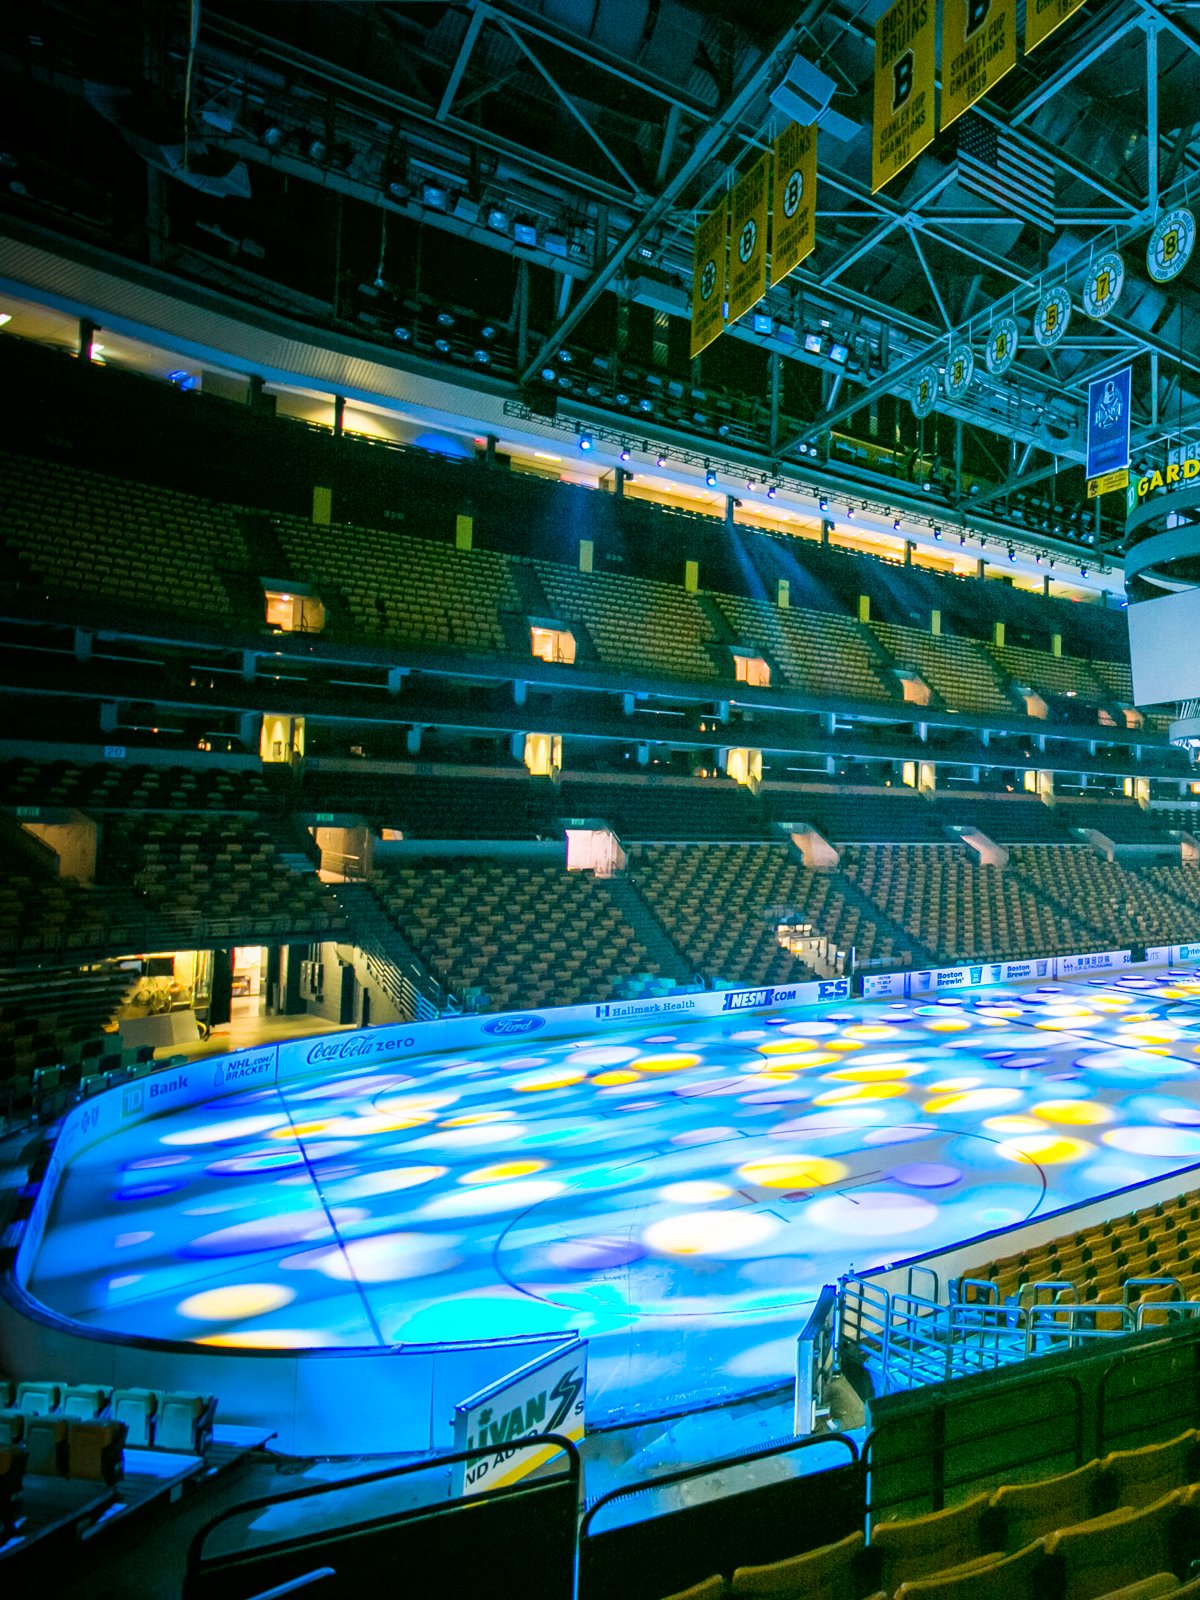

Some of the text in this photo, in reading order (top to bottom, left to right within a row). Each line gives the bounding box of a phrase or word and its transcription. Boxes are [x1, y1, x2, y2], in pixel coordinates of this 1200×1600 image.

[951, 12, 1006, 77] STANLEY CUP
[950, 32, 1006, 97] CHAMPIONS
[1165, 235, 1176, 256] 8
[1099, 277, 1108, 296] 7
[1048, 308, 1056, 326] 5
[937, 972, 963, 980] Boston
[937, 977, 964, 987] Brewin'
[612, 1003, 661, 1017] Hallmark
[663, 999, 696, 1011] Health
[493, 1017, 534, 1034] Ford
[306, 1033, 416, 1065] Coca-Cola zero
[225, 1063, 271, 1082] BRACKET
[149, 1074, 189, 1099] Bank
